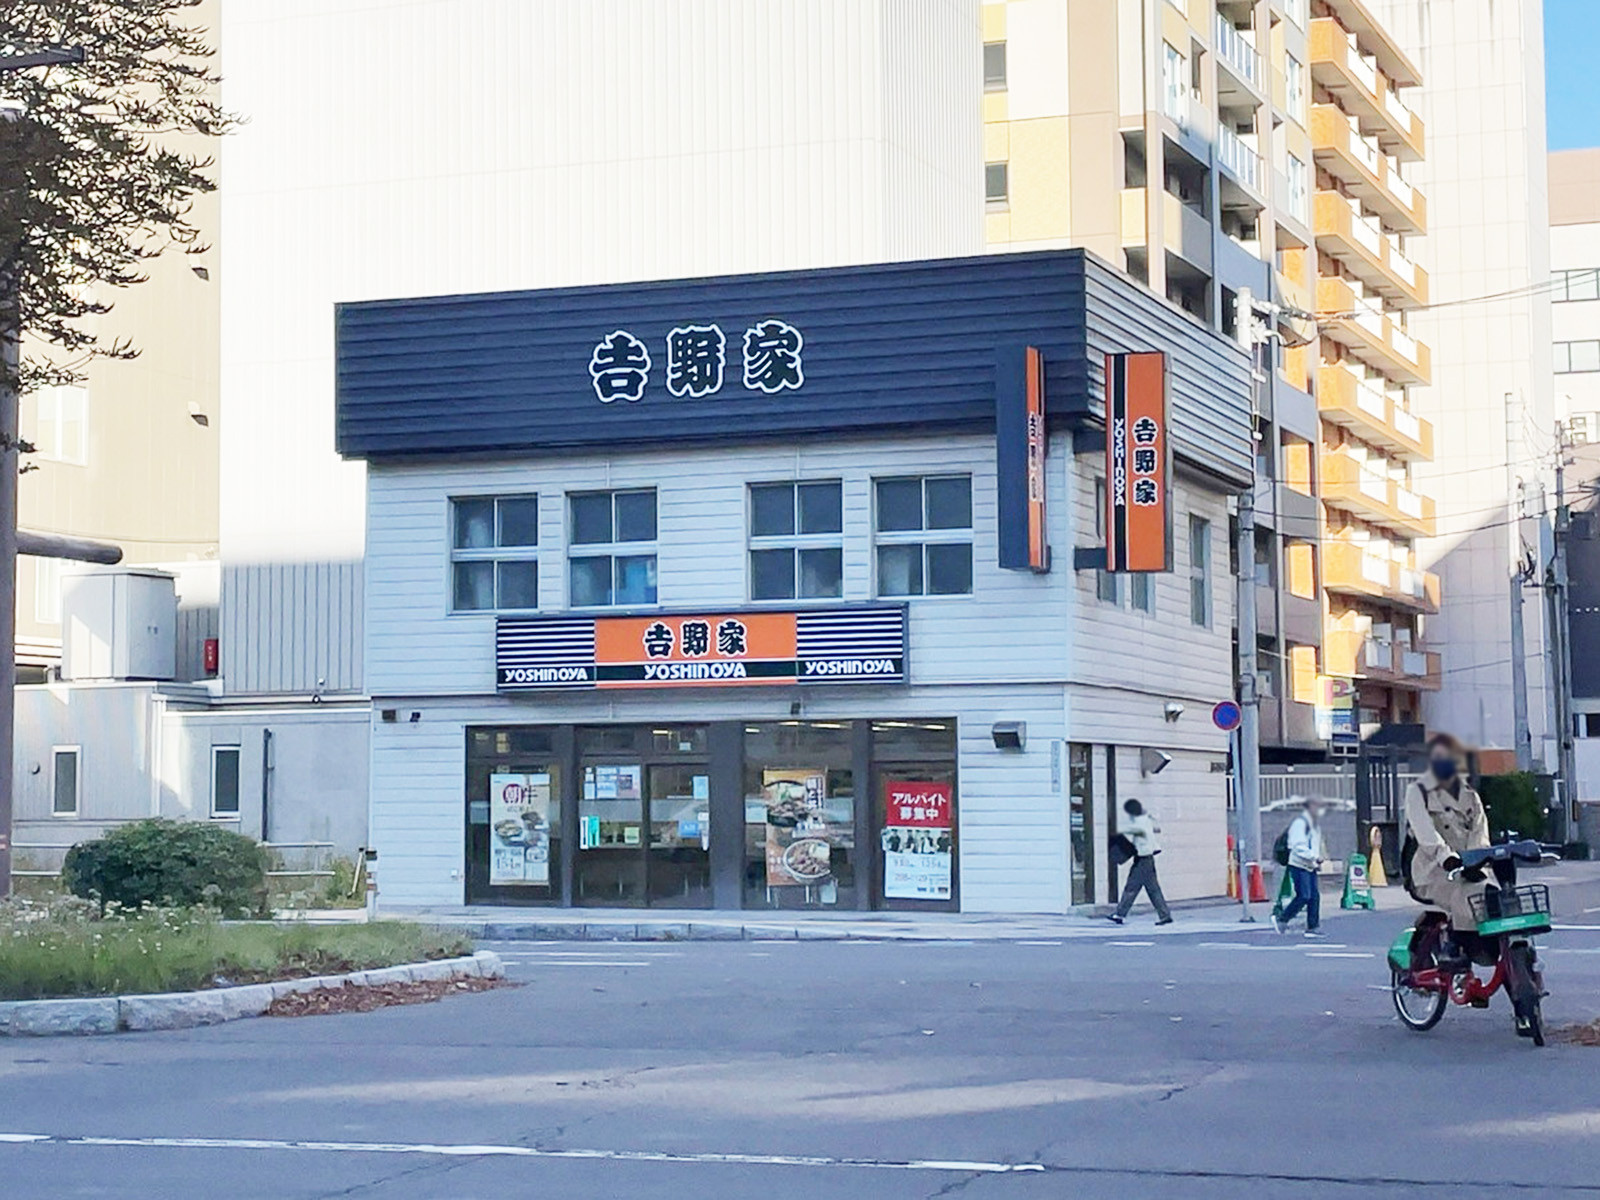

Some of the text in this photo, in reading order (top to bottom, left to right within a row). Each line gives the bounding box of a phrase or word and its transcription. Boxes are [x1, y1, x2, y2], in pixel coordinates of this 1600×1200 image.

[589, 319, 804, 403] 吉野家
[1114, 418, 1125, 506] YOSHINOYA
[1132, 415, 1159, 507] 吉野家
[642, 619, 748, 659] 吉野家
[505, 667, 588, 682] YOSHINOYA
[644, 662, 747, 680] YOSHINOYA
[805, 659, 895, 675] YOSHINOYA
[1325, 680, 1349, 706] P
[892, 793, 947, 806] アルバイト
